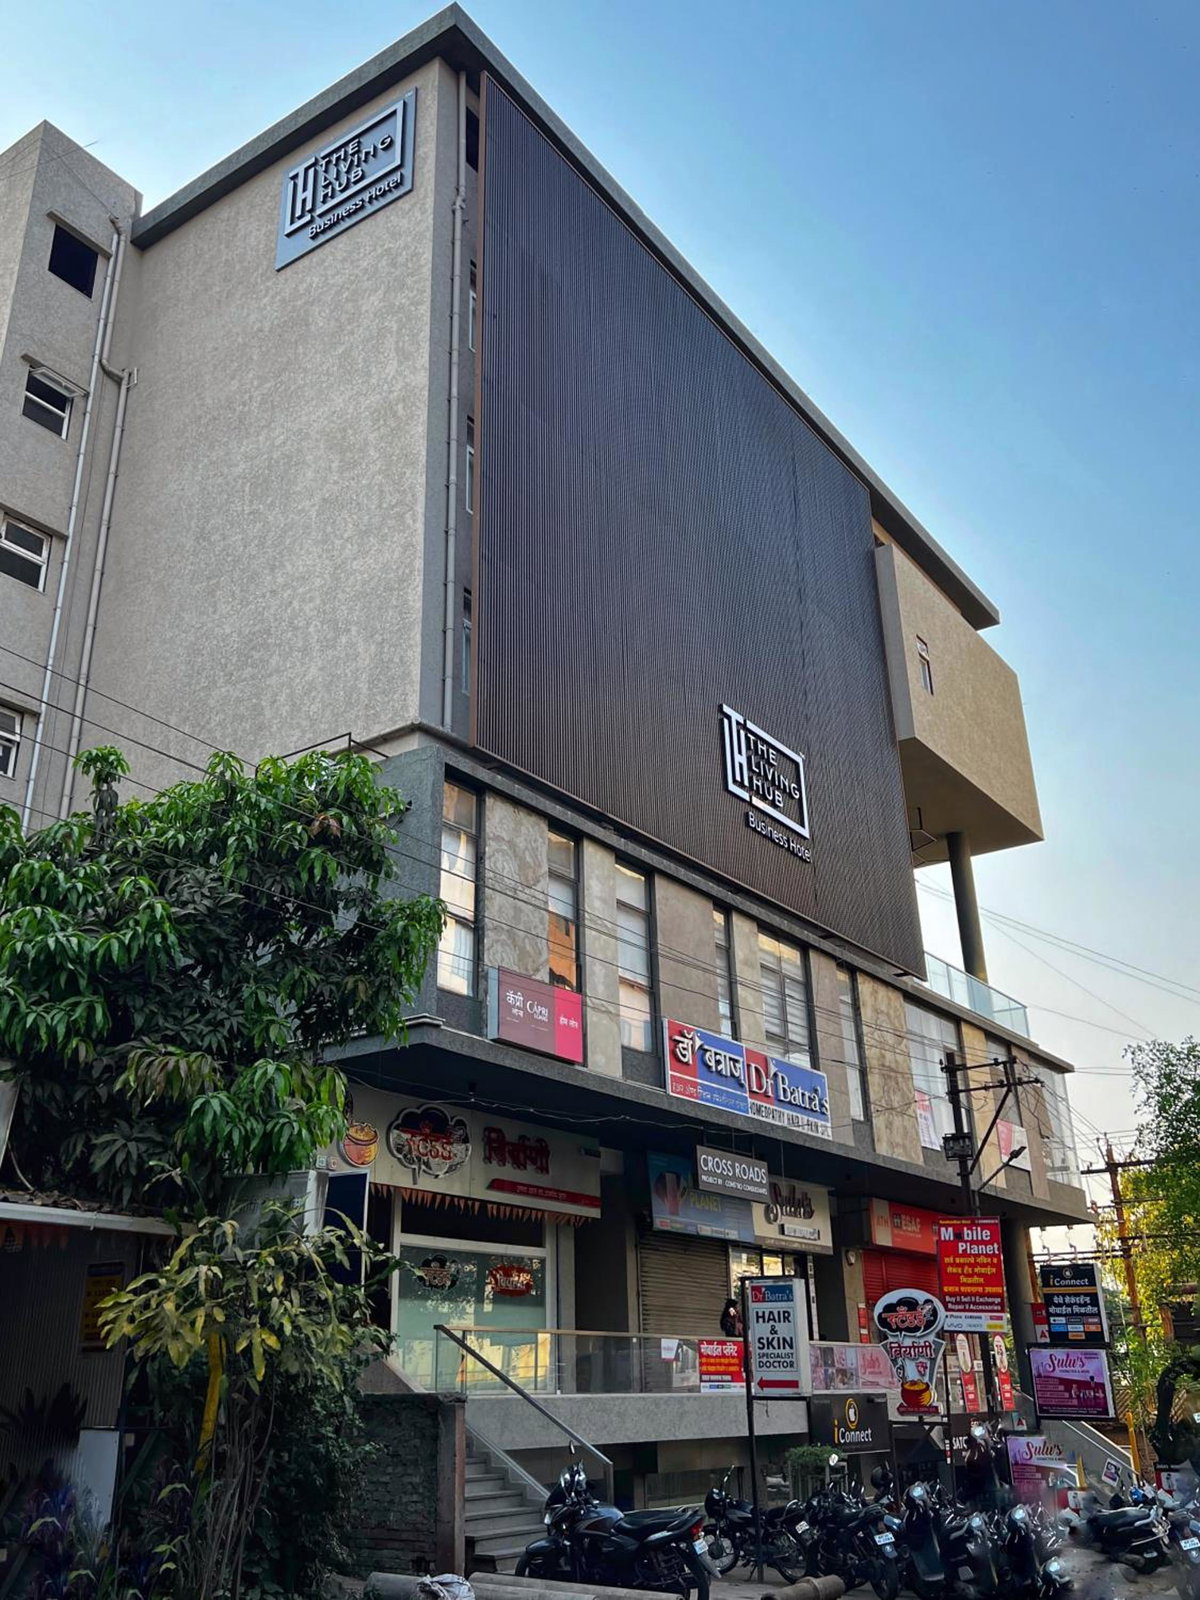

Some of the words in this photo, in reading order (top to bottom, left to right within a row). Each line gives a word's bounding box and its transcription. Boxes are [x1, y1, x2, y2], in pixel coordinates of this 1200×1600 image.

[319, 138, 361, 171] THE
[321, 134, 393, 187] LIVING
[320, 167, 363, 203] HUB
[308, 197, 363, 238] Business
[366, 171, 402, 202] Hotel
[747, 733, 777, 766] THE
[751, 756, 800, 799] LIVING
[752, 777, 784, 808] HUB
[748, 812, 788, 849] Business
[748, 1062, 774, 1098] Dr
[777, 1071, 829, 1115] Batra's
[700, 1154, 734, 1177] CROSS
[735, 1161, 767, 1184] ROADS
[958, 1242, 1000, 1255] Planet
[752, 1288, 764, 1302] Dr
[764, 1289, 794, 1302] Batra's
[755, 1309, 792, 1324] HAIR
[769, 1324, 779, 1336] &
[757, 1336, 794, 1351] SKIN
[757, 1352, 794, 1360] SPECIALIST
[758, 1360, 795, 1370] DOCTOR
[1045, 1353, 1086, 1373] Sulu's
[1022, 1441, 1063, 1461] Sulu's
